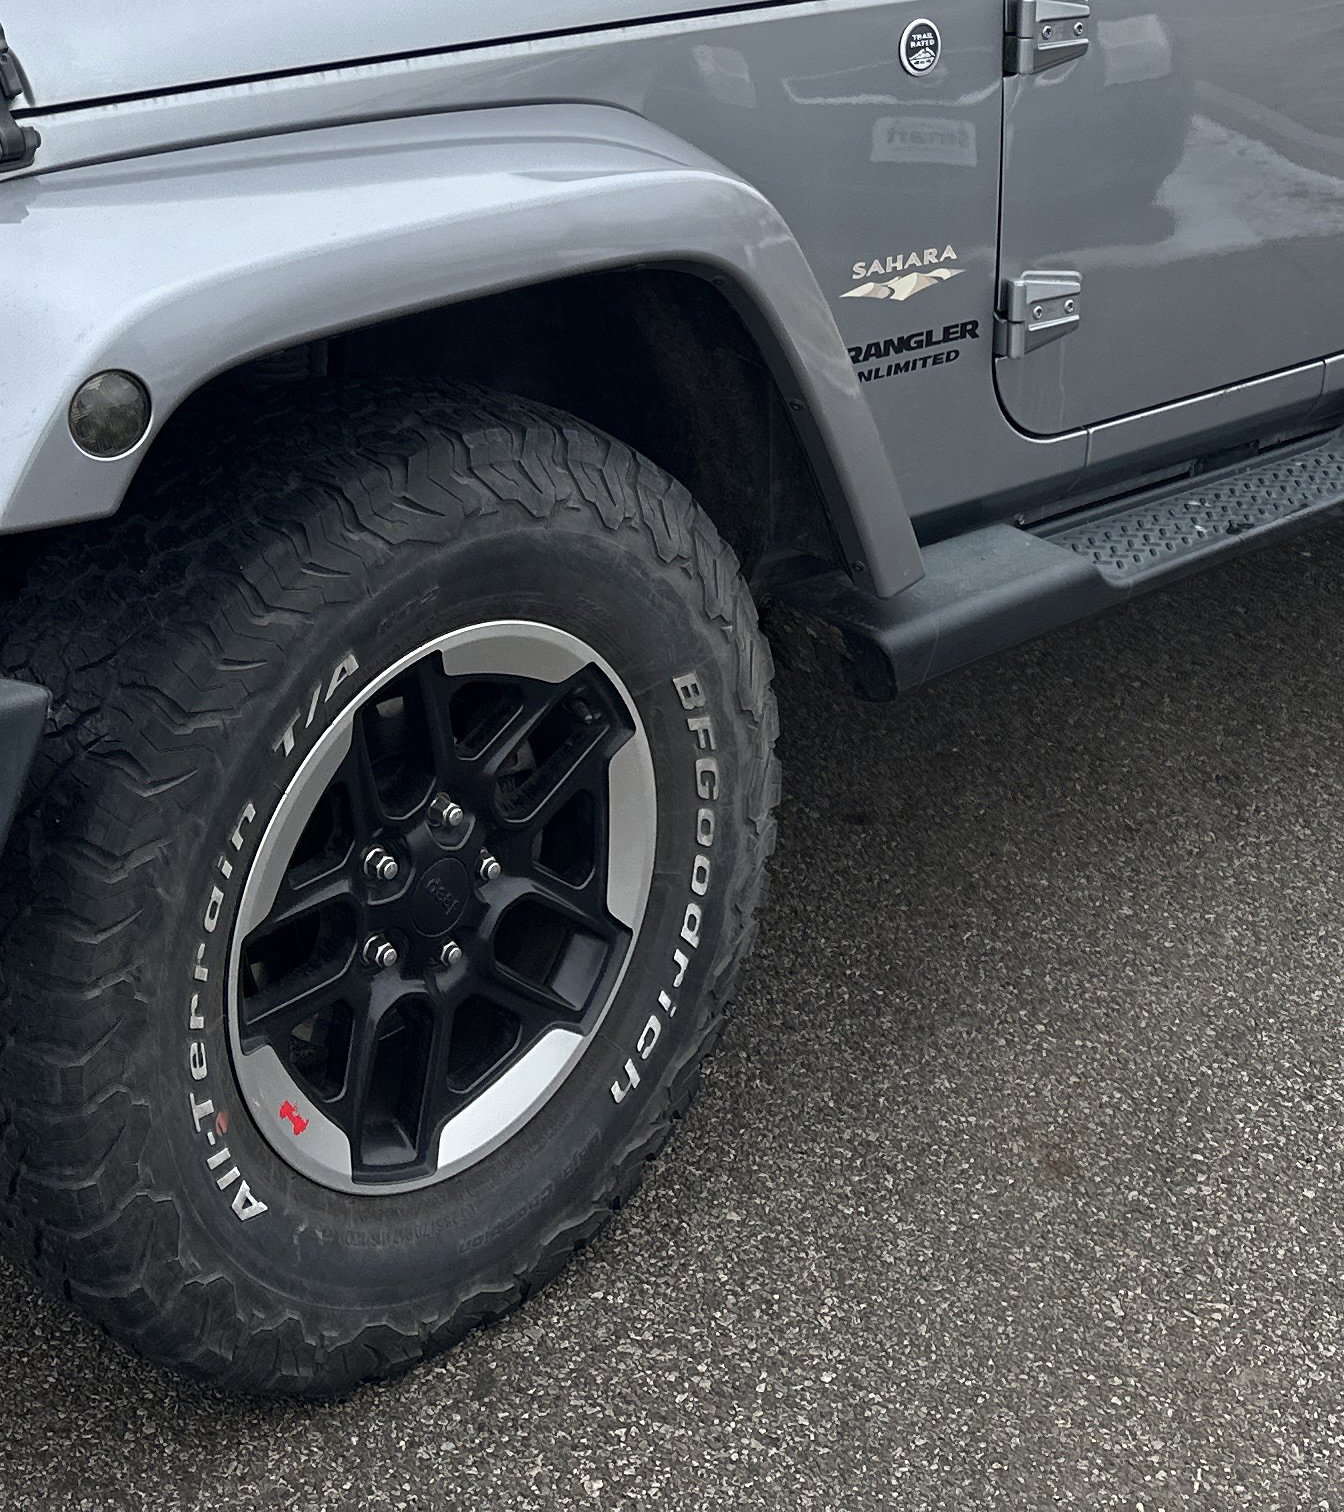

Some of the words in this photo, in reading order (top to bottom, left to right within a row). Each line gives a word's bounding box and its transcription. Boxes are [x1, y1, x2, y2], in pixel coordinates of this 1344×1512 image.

[911, 32, 934, 41] TRAIL
[852, 245, 958, 280] SAHARA
[847, 319, 980, 365] RANGLER
[857, 349, 960, 383] NLIMITED
[272, 652, 360, 758] T/A
[611, 672, 720, 1104] BFGoodrich
